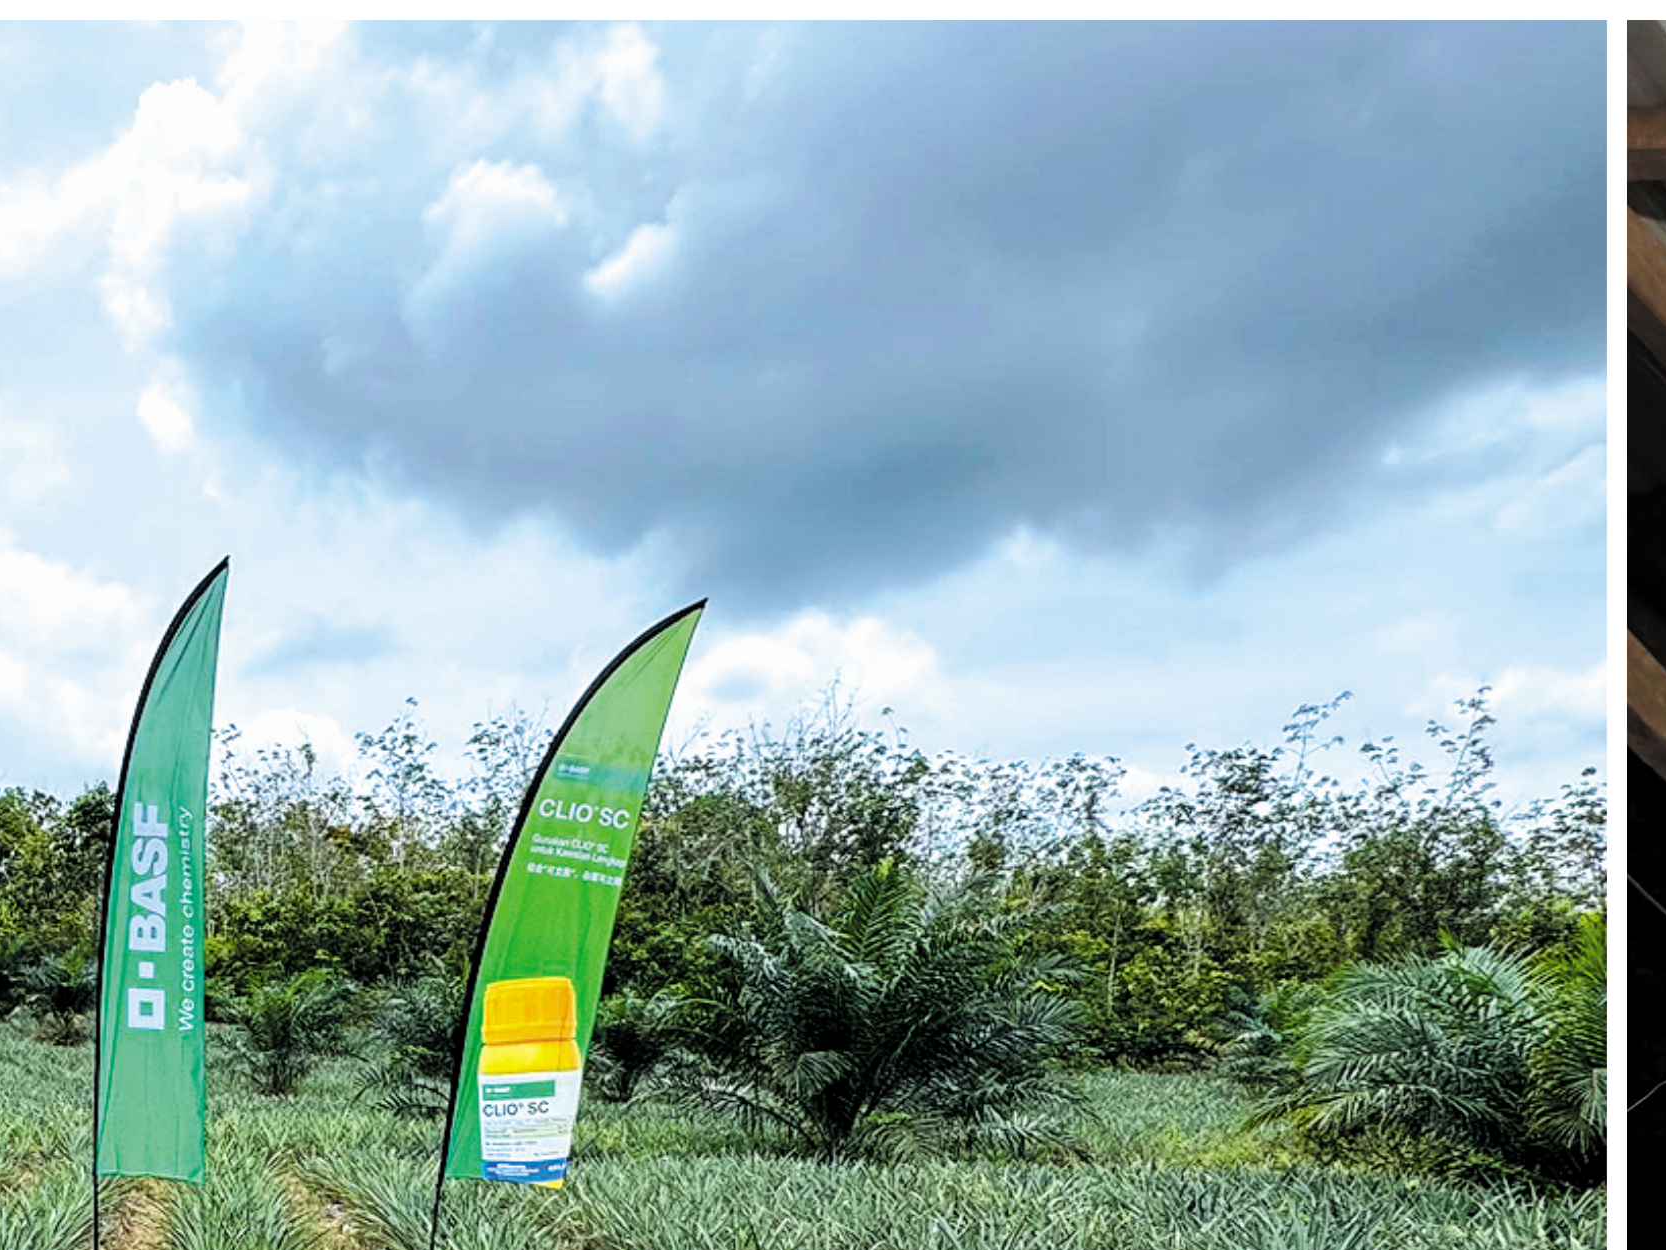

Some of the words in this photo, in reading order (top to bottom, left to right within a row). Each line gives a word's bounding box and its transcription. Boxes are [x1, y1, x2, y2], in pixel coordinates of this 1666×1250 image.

[598, 807, 631, 829] SC
[129, 802, 169, 952] BASF
[179, 807, 194, 918] chemistry
[181, 924, 195, 992] create
[179, 998, 195, 1031] We
[528, 1100, 549, 1115] SC
